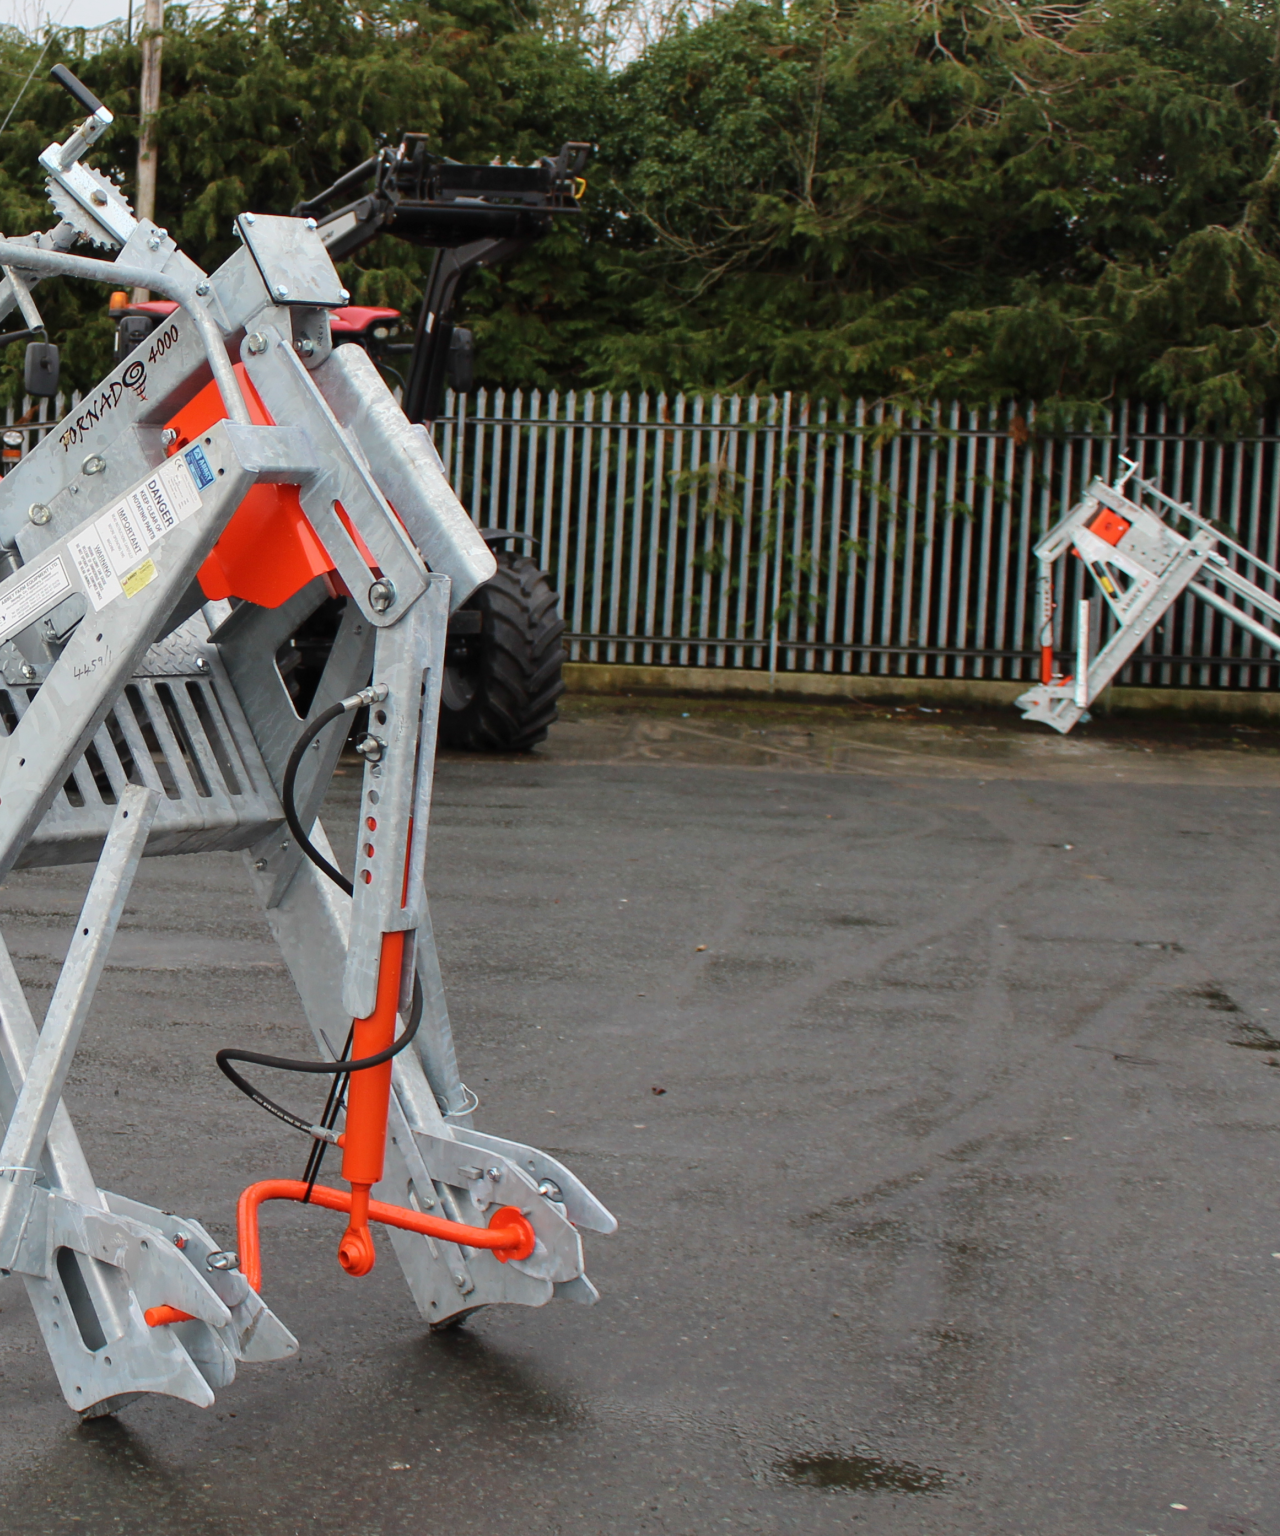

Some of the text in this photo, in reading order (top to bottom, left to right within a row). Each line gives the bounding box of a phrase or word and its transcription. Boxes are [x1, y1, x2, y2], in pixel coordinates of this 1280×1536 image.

[59, 324, 179, 452] TORNADO 4000
[132, 494, 156, 540] ROTATING PARTS
[140, 489, 162, 533] KEEP CLEAR OF
[148, 479, 174, 528] DANGER
[117, 507, 142, 555] IMPORTANT
[94, 544, 112, 578] WARNING
[1, 593, 13, 605] ABBEY
[15, 585, 25, 595] FARM
[26, 568, 48, 587] EQUIPMENT
